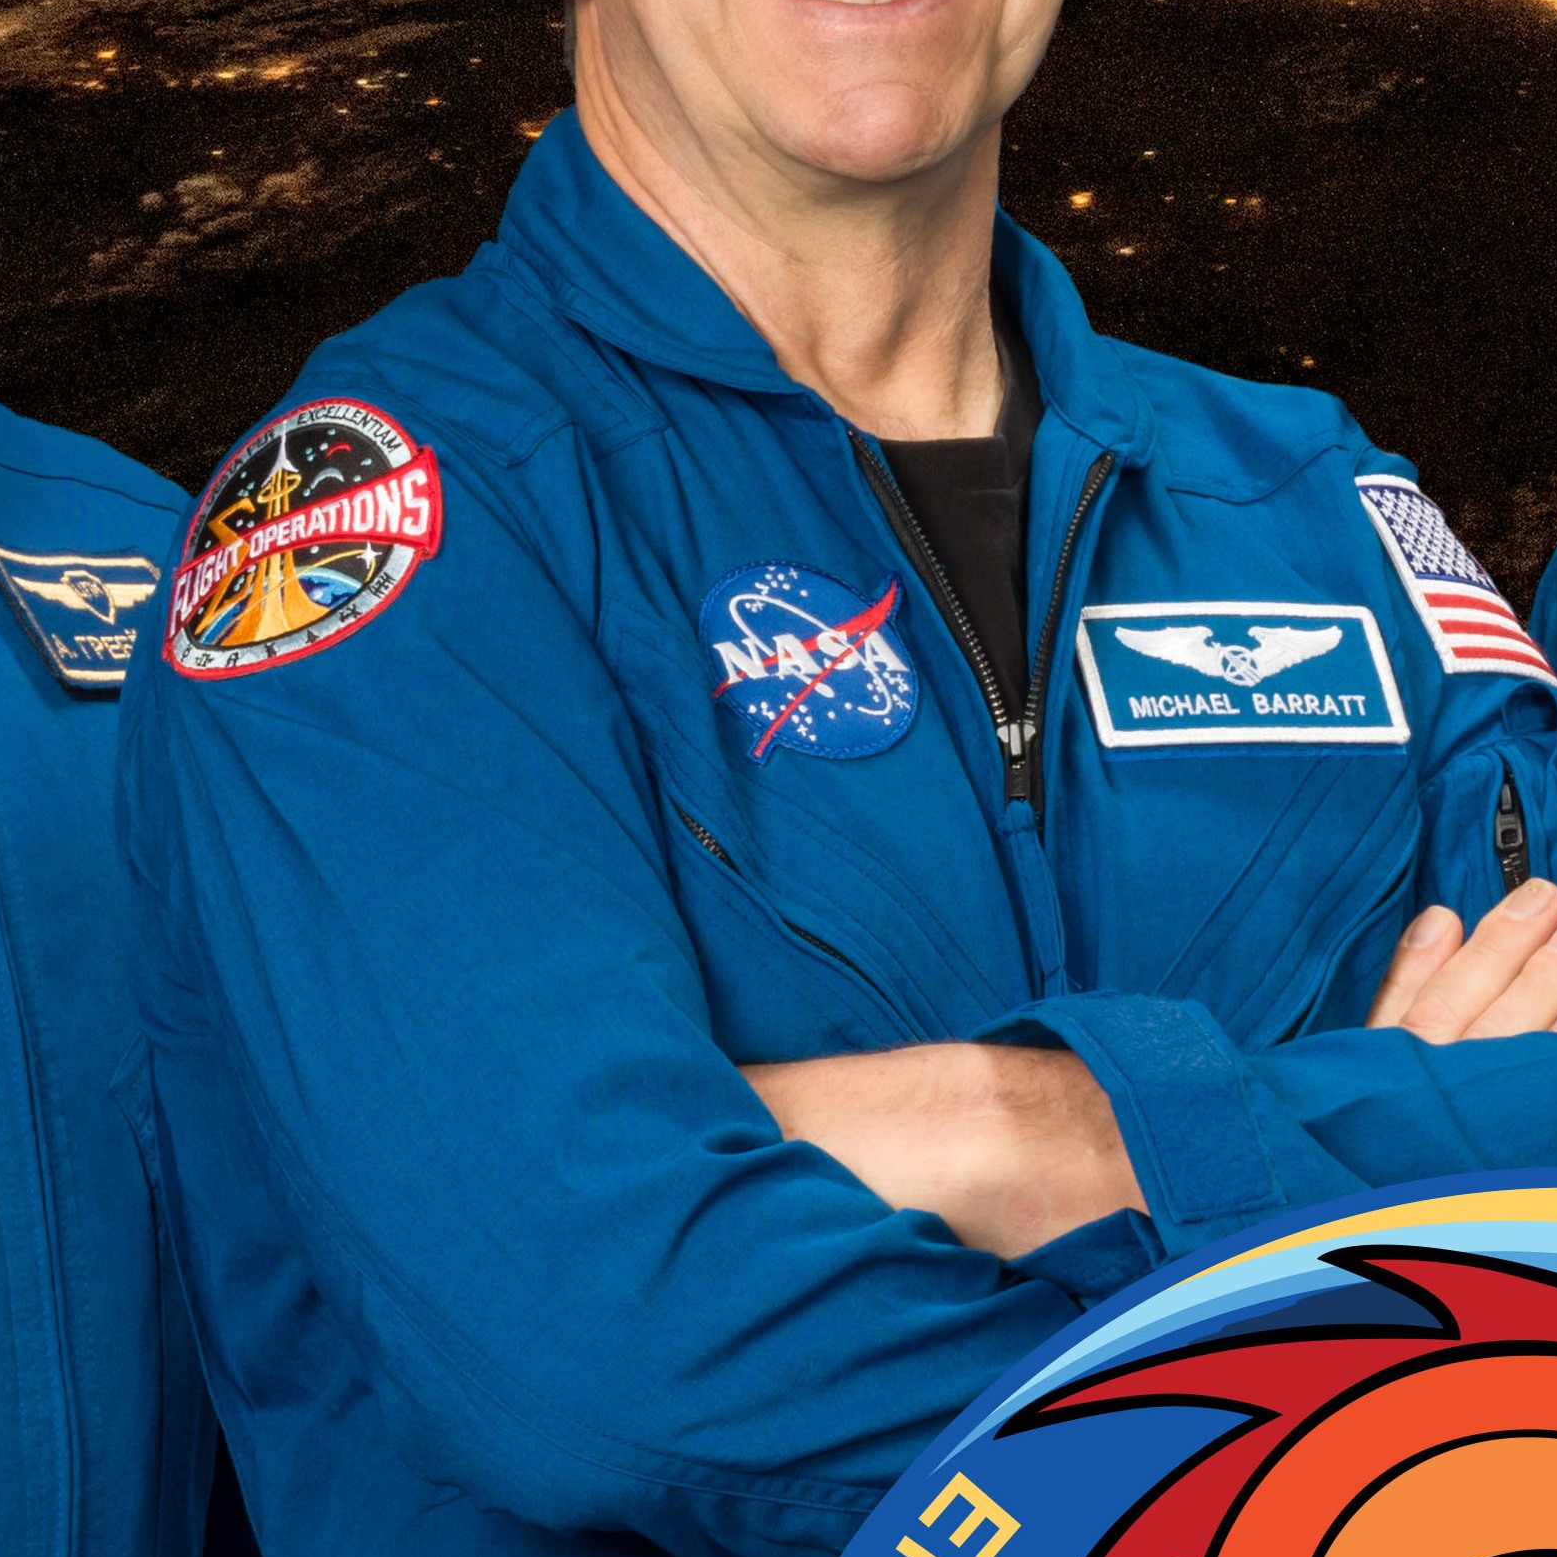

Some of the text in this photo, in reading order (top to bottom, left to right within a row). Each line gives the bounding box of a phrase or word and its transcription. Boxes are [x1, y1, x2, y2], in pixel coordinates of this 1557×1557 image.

[297, 405, 403, 453] EXCELLENTIAM
[170, 469, 430, 637] FLIGHT OPERATIONS
[712, 630, 910, 684] NASA
[1128, 693, 1366, 719] MICHAEL BARRATT
